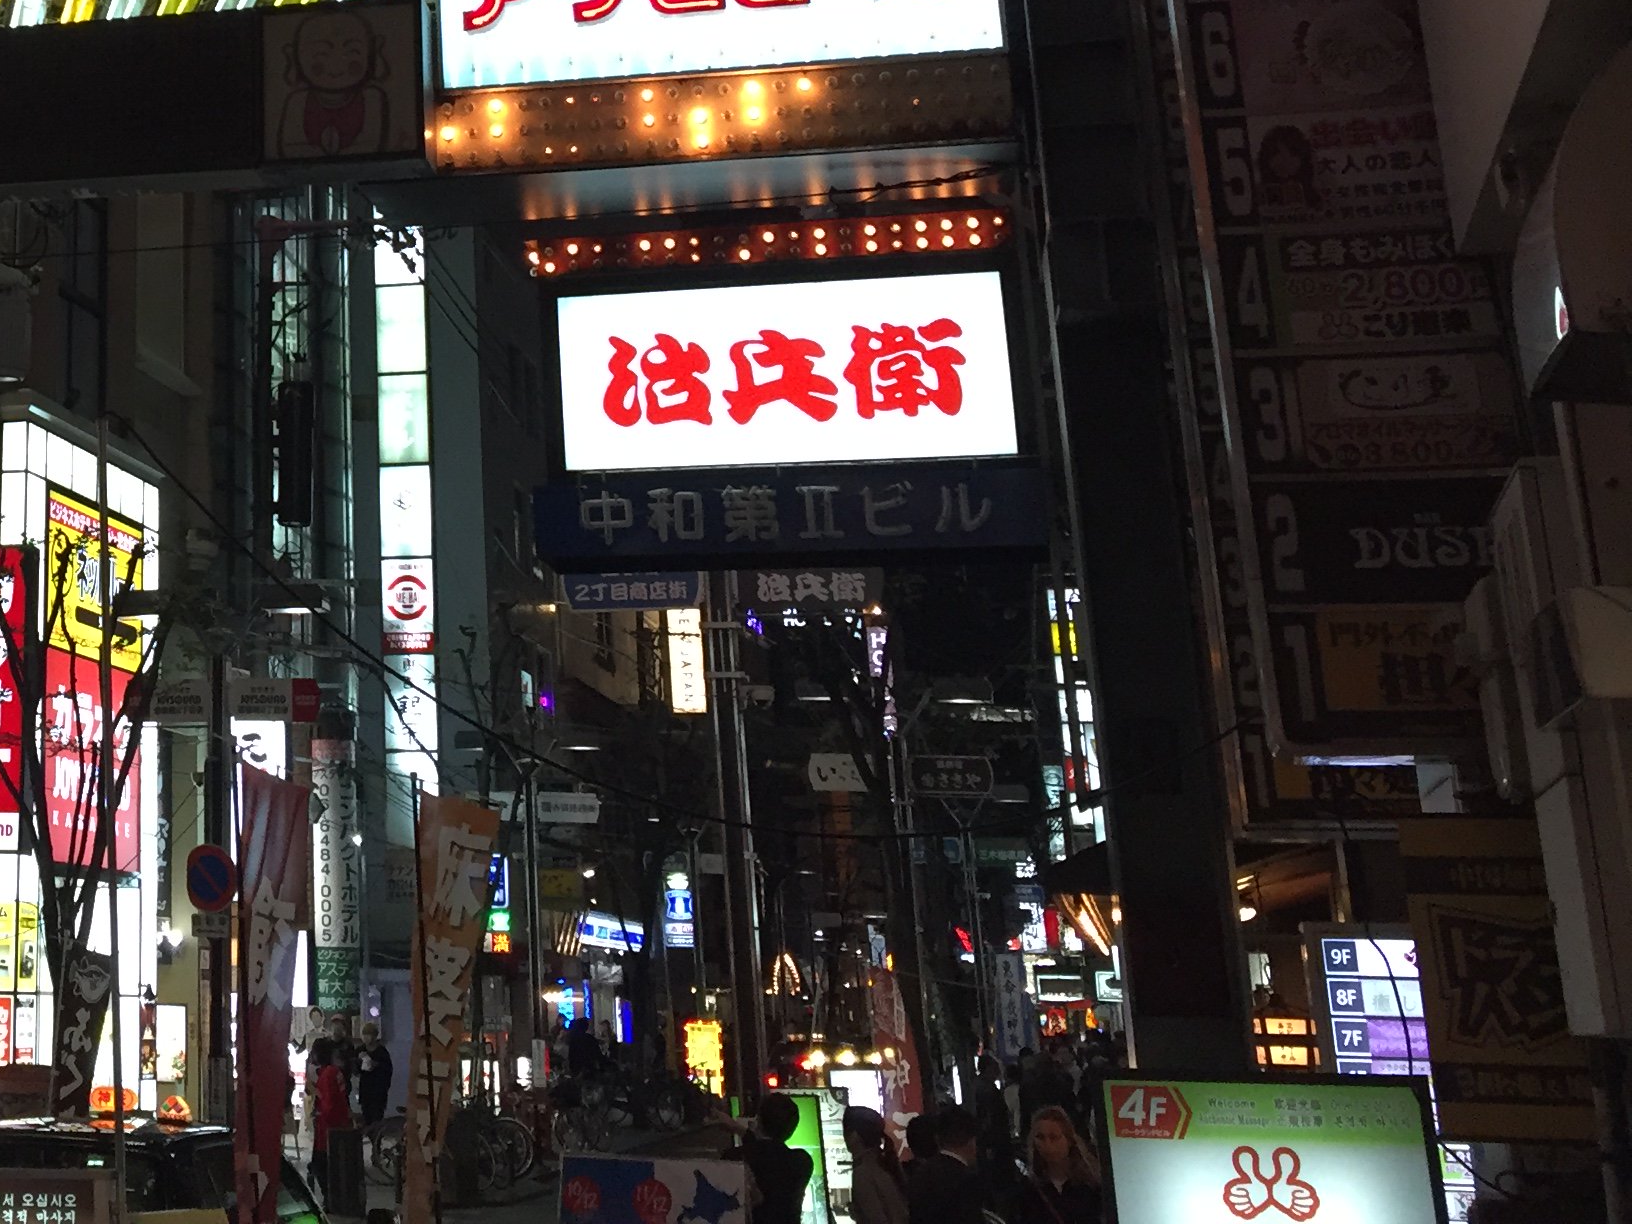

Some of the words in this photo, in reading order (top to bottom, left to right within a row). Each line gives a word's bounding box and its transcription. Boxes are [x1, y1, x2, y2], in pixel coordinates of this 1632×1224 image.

[1201, 10, 1236, 98] 6
[1216, 127, 1254, 216] 5
[1237, 246, 1269, 345] 4
[1249, 366, 1286, 462] 3
[1267, 493, 1306, 592] 2
[574, 580, 688, 603] 2丁目商店街
[1283, 623, 1317, 723] 1
[493, 933, 511, 953] 満
[1330, 948, 1352, 965] 9F
[1336, 988, 1358, 1007] 8F
[1341, 1029, 1363, 1047] 7F
[1118, 1088, 1168, 1127] 4F
[1208, 1098, 1256, 1109] Welcome
[21, 1192, 77, 1208] 오십시오
